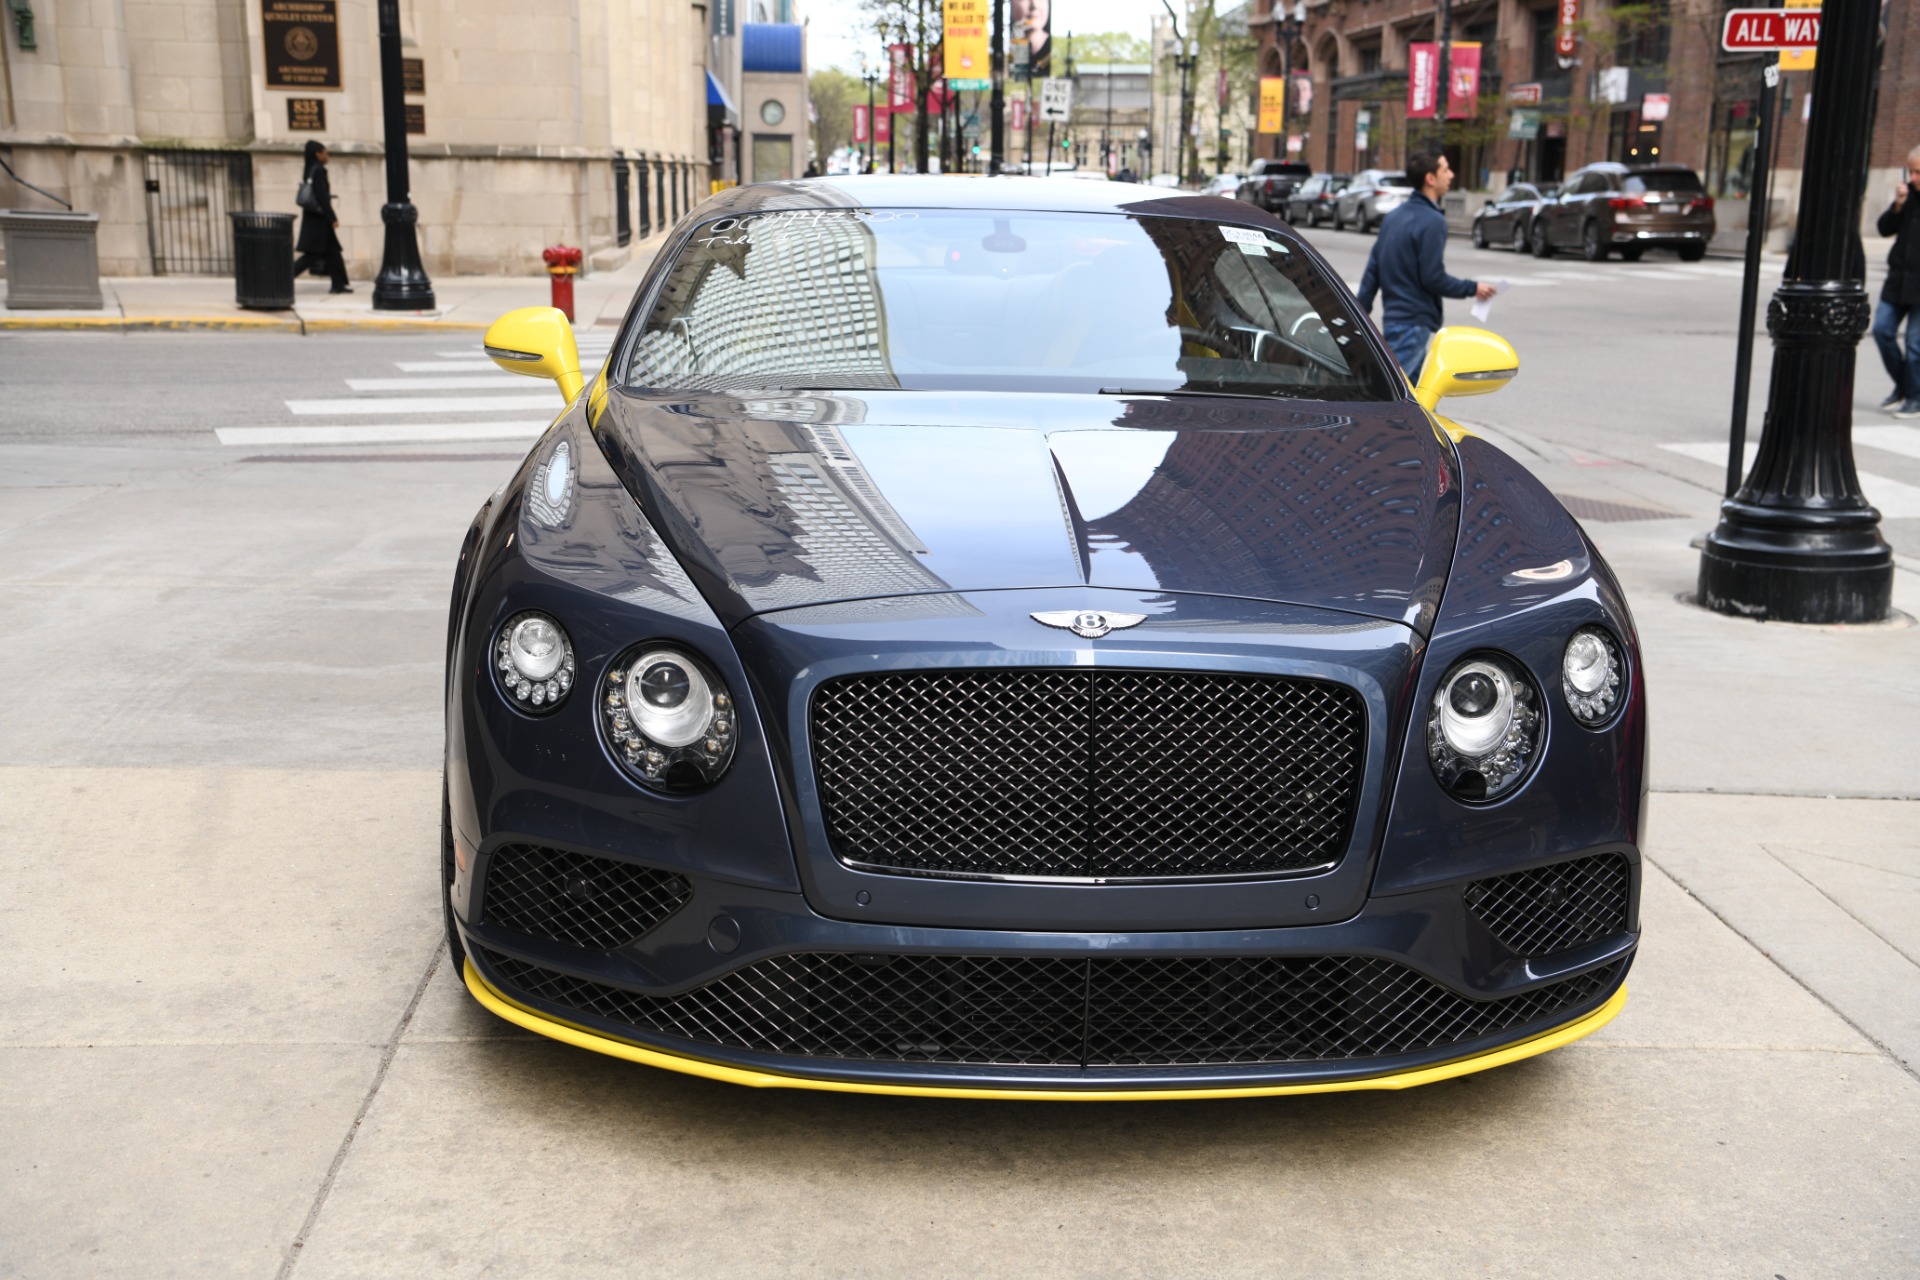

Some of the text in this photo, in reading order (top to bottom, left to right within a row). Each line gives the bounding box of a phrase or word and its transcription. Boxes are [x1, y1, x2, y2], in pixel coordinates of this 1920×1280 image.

[948, 2, 958, 10] WE
[1735, 18, 1820, 42] ALL WAY
[1412, 50, 1428, 112] WELCOME
[1045, 82, 1068, 93] ONE
[1044, 94, 1068, 105] WAY
[293, 100, 318, 114] 835
